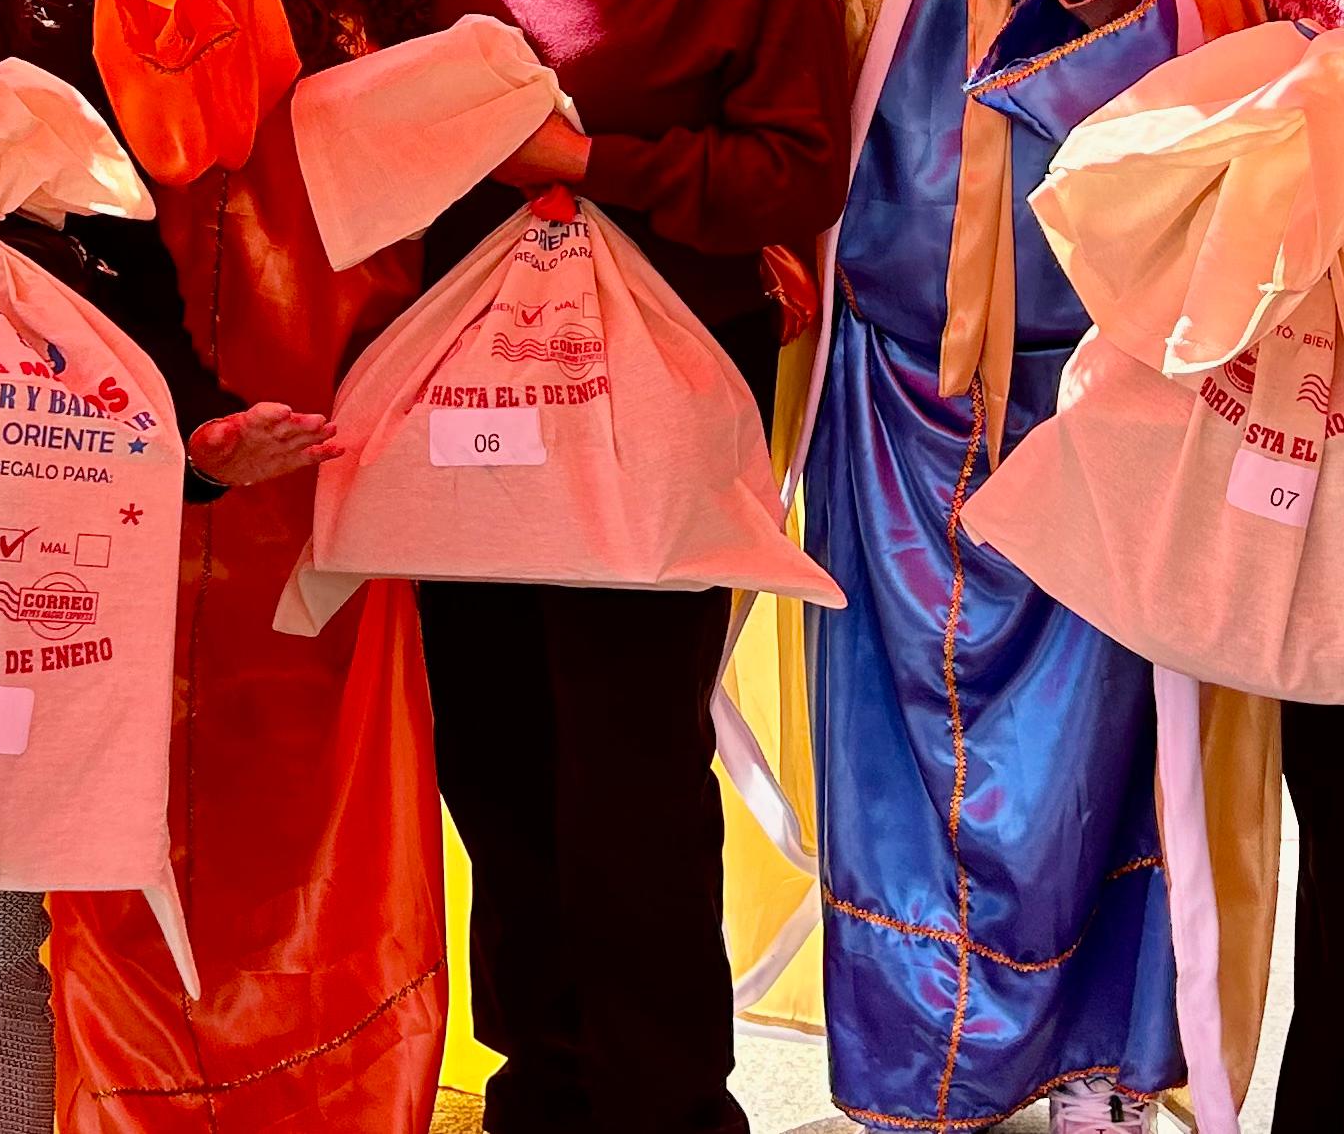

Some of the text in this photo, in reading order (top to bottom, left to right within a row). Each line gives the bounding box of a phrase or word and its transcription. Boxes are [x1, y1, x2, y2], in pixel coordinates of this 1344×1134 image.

[549, 339, 603, 354] CORREO
[1302, 333, 1334, 351] BIEN
[27, 385, 42, 412] Y
[430, 385, 489, 408] HASTA
[495, 386, 520, 407] EL
[525, 385, 537, 405] 6
[543, 385, 565, 405] DE
[567, 375, 611, 405] ENER
[1199, 376, 1246, 427] ABRIR
[1245, 423, 1285, 455] STA
[1290, 437, 1318, 463] EL
[2, 421, 117, 454] ORIENTE
[474, 433, 501, 453] 06
[63, 466, 114, 484] PARA:
[1270, 487, 1301, 510] 07
[40, 541, 71, 555] MAL
[23, 593, 94, 612] CORREO
[5, 649, 34, 675] DE
[41, 636, 113, 672] ENERO
